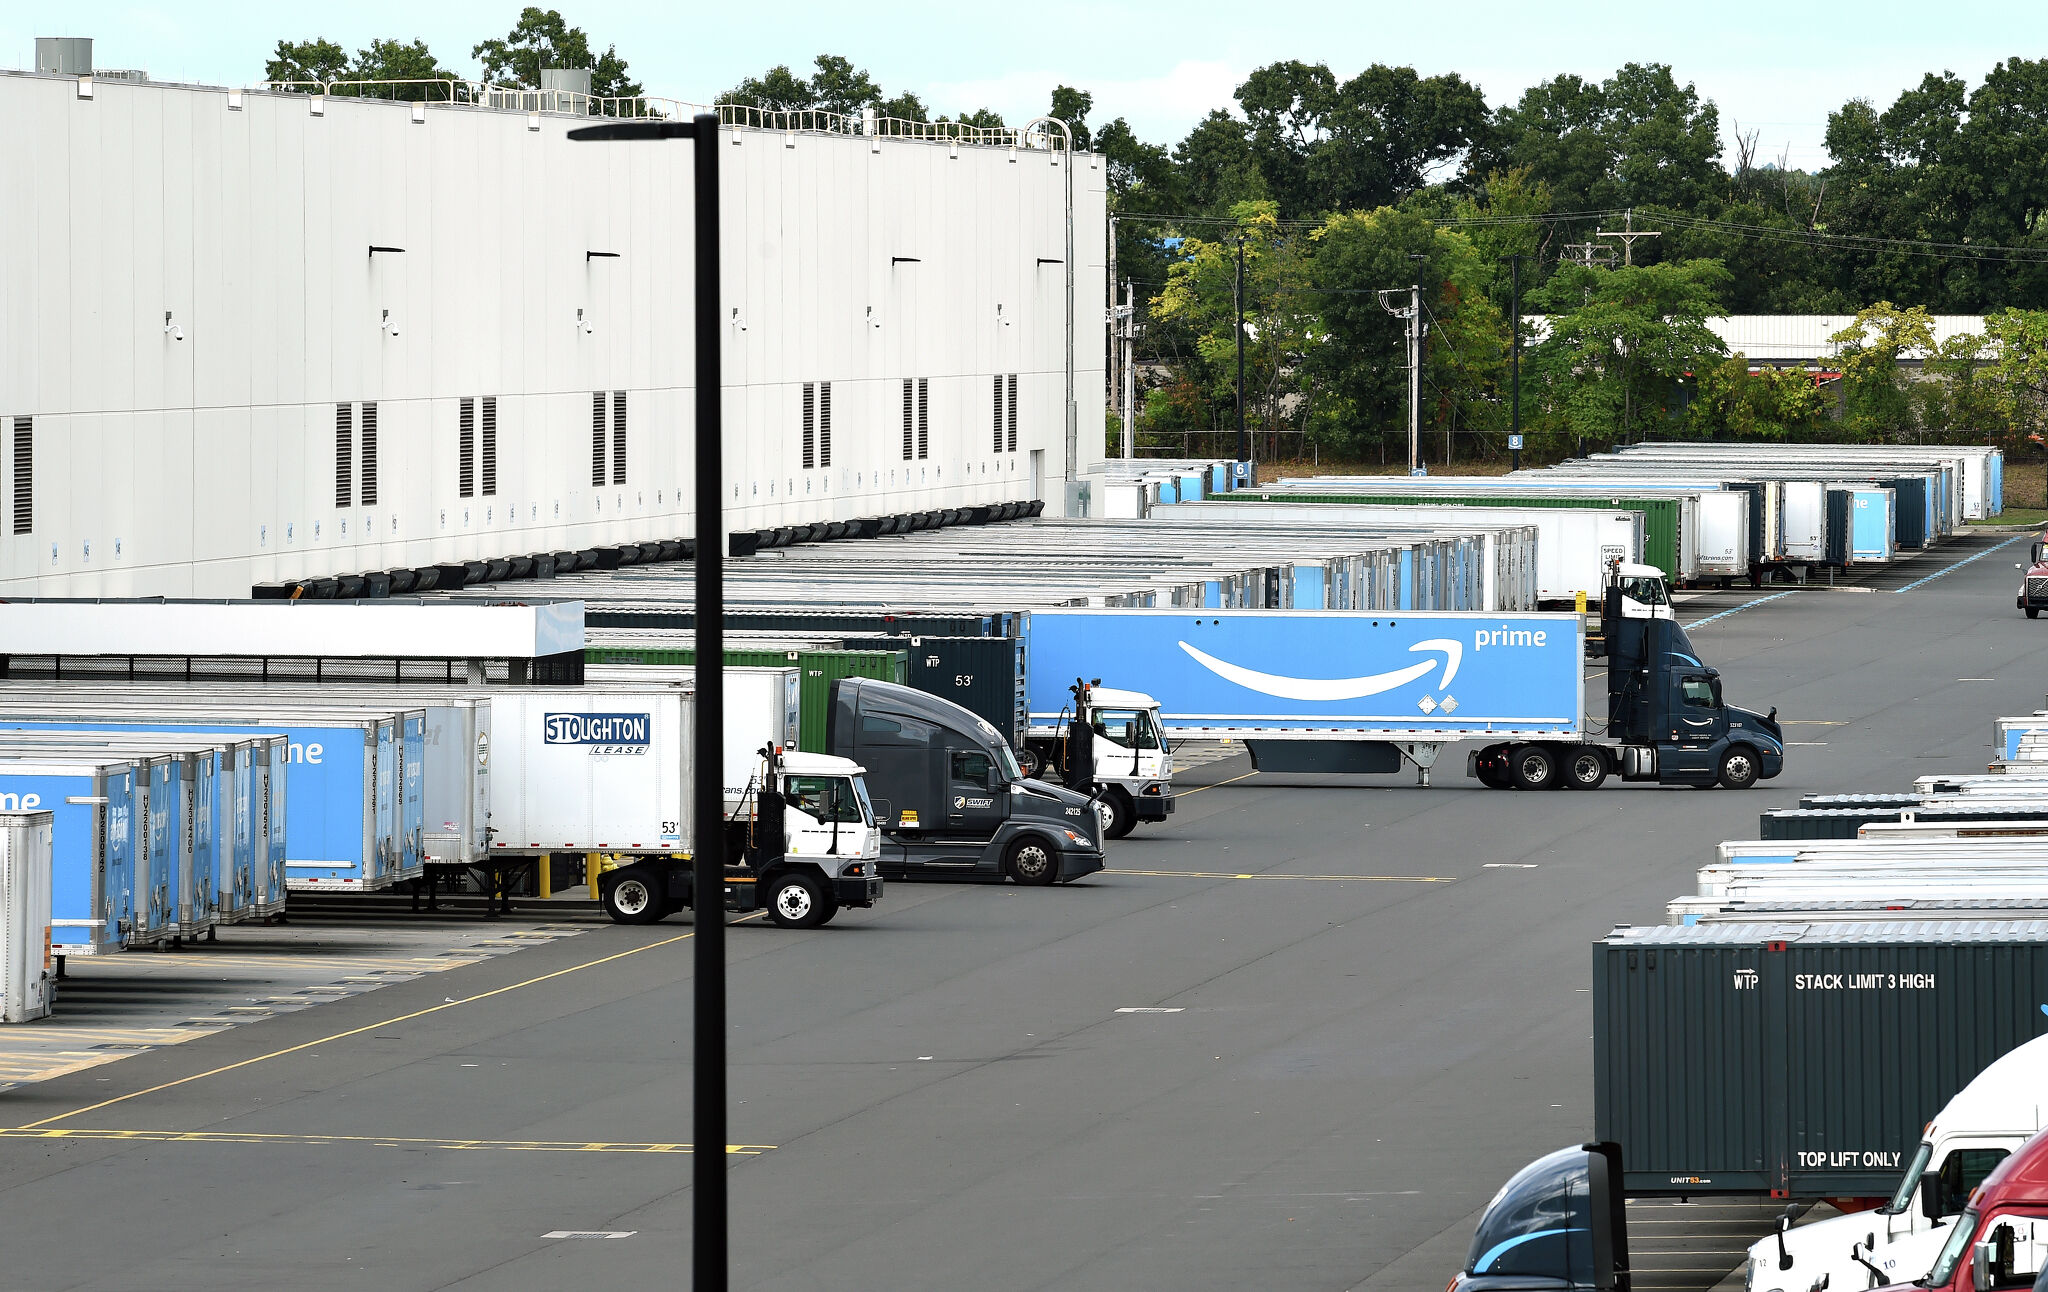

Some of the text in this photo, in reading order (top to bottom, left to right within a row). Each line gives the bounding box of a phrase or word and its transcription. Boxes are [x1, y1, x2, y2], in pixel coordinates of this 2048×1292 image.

[1512, 436, 1519, 446] 8
[1236, 463, 1245, 475] 6
[1475, 624, 1547, 652] prime
[926, 658, 940, 668] WTP
[955, 675, 973, 686] 53'
[547, 717, 645, 741] STOUGHTON
[594, 746, 645, 754] LEASE
[967, 798, 994, 806] SWIFT
[662, 821, 679, 834] 53'
[1733, 975, 1759, 990] WTP
[1795, 974, 1935, 990] STACK LIMIT 3 HIGH
[1797, 1151, 1901, 1167] TOP LIFT ONLY
[1883, 1259, 1897, 1270] 10
